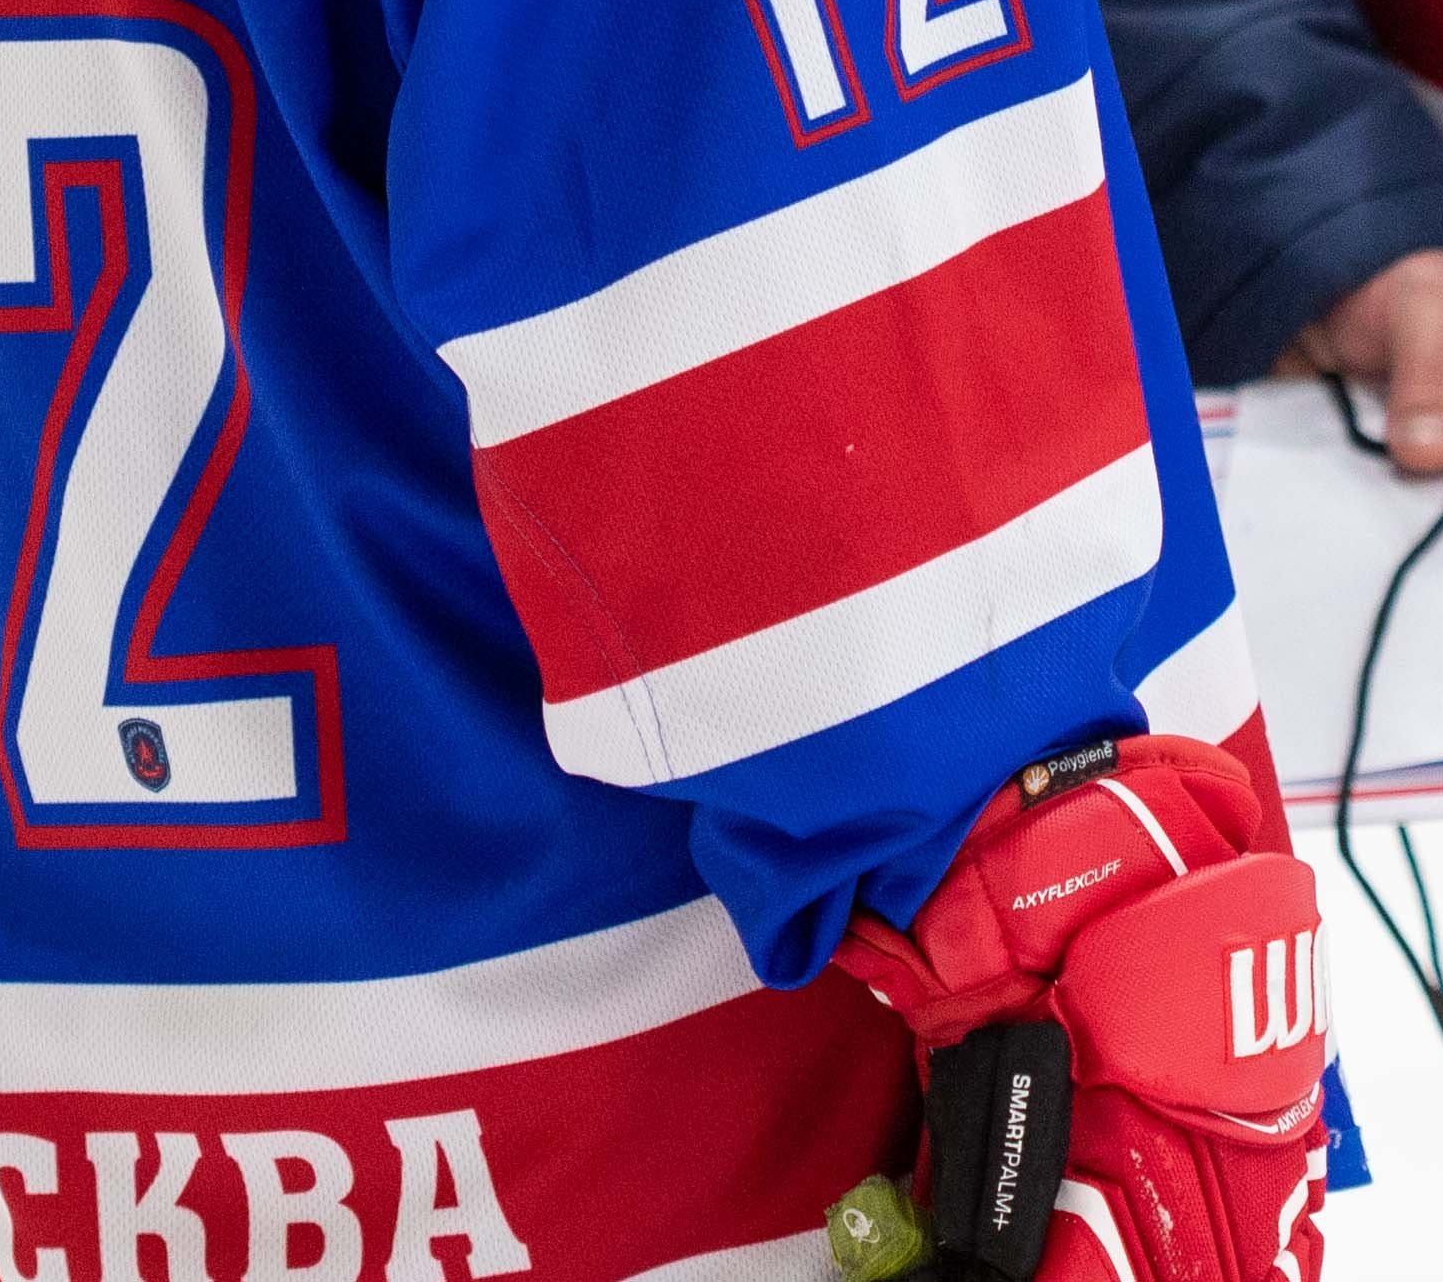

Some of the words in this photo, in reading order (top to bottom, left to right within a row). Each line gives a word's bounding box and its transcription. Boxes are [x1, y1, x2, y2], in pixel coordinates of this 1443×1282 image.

[1047, 743, 1113, 777] Polygiene
[1011, 858, 1123, 911] AXYFLEXCUFF
[1229, 920, 1328, 1059] W
[1277, 1096, 1315, 1135] AXYFLEX
[992, 1073, 1032, 1232] SMARTPALM+
